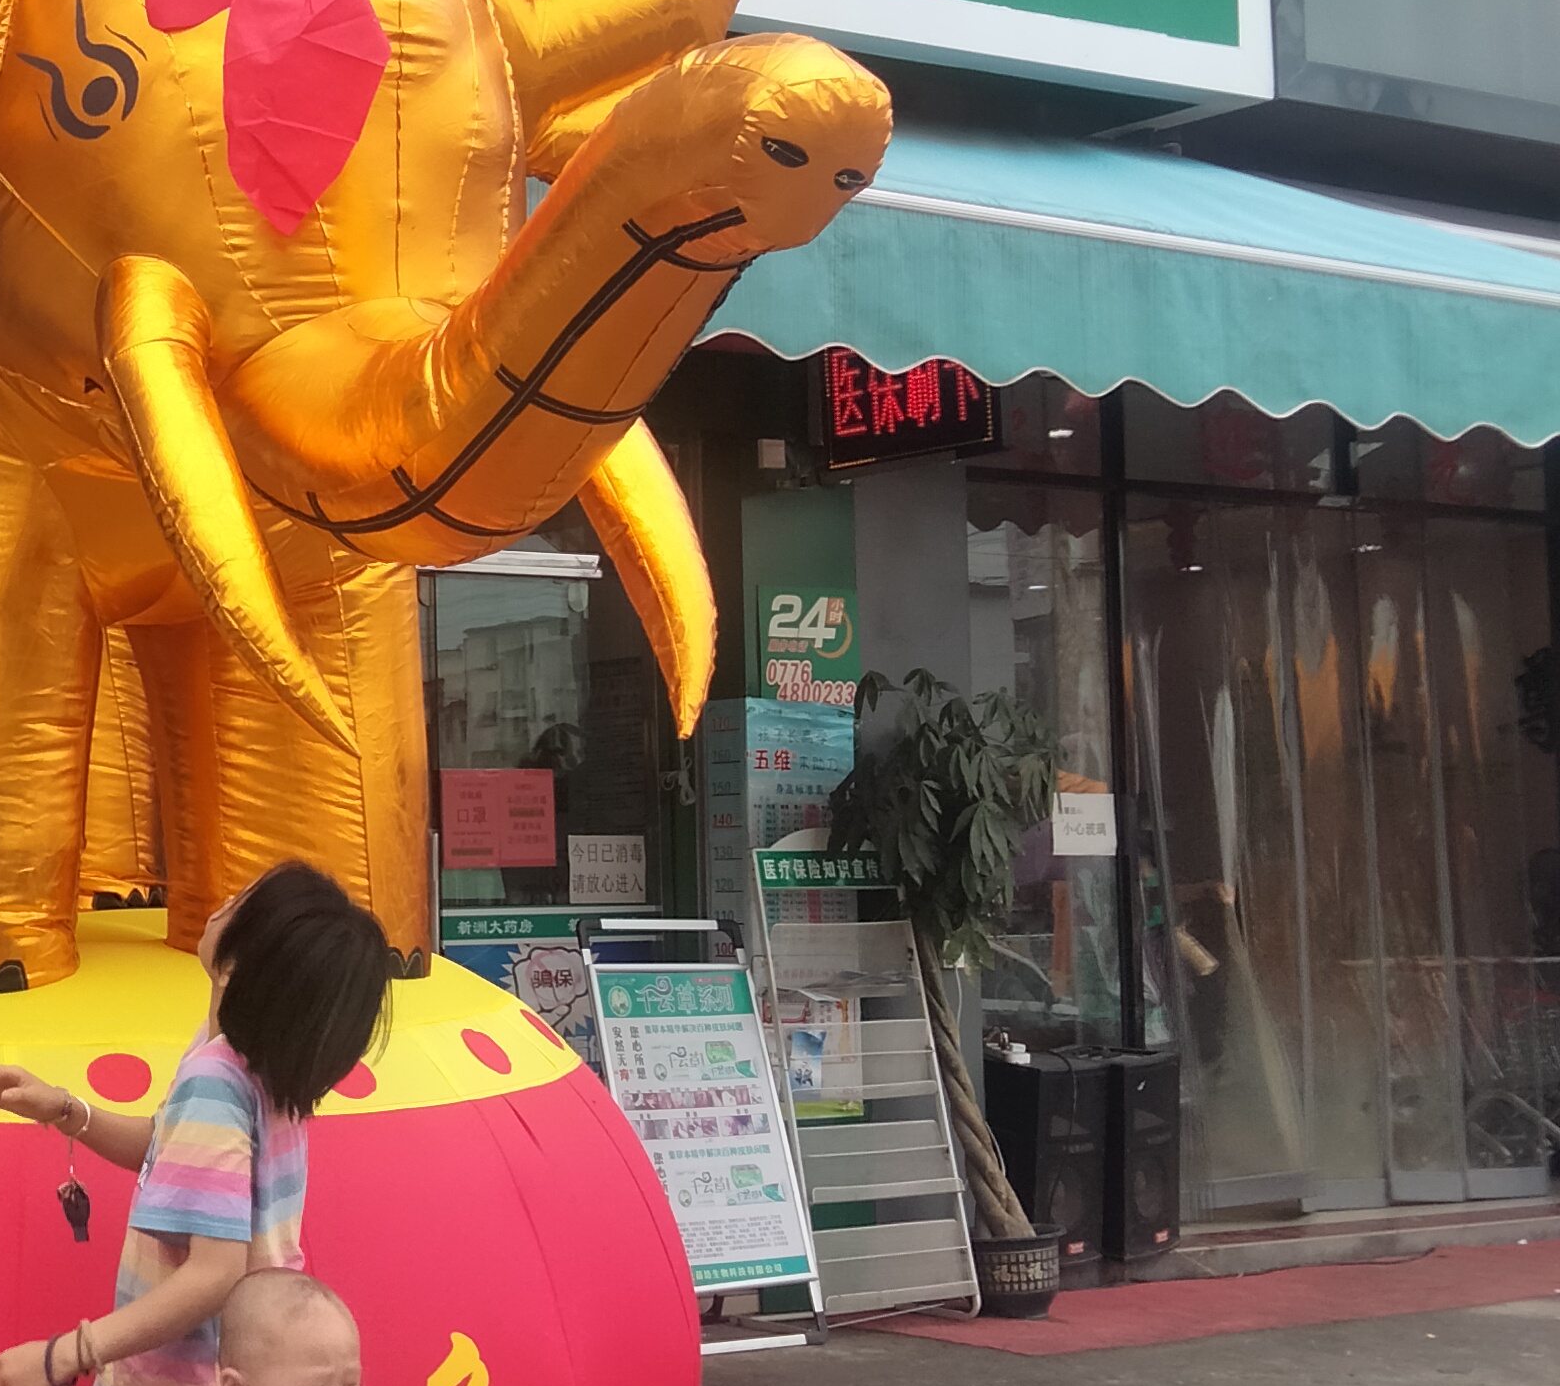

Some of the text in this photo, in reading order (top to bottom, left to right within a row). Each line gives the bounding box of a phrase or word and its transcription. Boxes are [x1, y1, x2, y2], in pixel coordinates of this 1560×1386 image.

[829, 598, 844, 623] 小时
[768, 594, 837, 649] 24
[767, 660, 811, 685] 0776
[777, 681, 856, 705] 4800233
[713, 814, 733, 826] 140
[571, 842, 644, 864] 今日已消毒
[714, 846, 733, 858] 130
[571, 873, 644, 894] 请放心进入
[715, 878, 734, 890] 120
[456, 919, 534, 935] 新洲大药房
[715, 943, 736, 955] 100
[532, 969, 574, 989] 骗保
